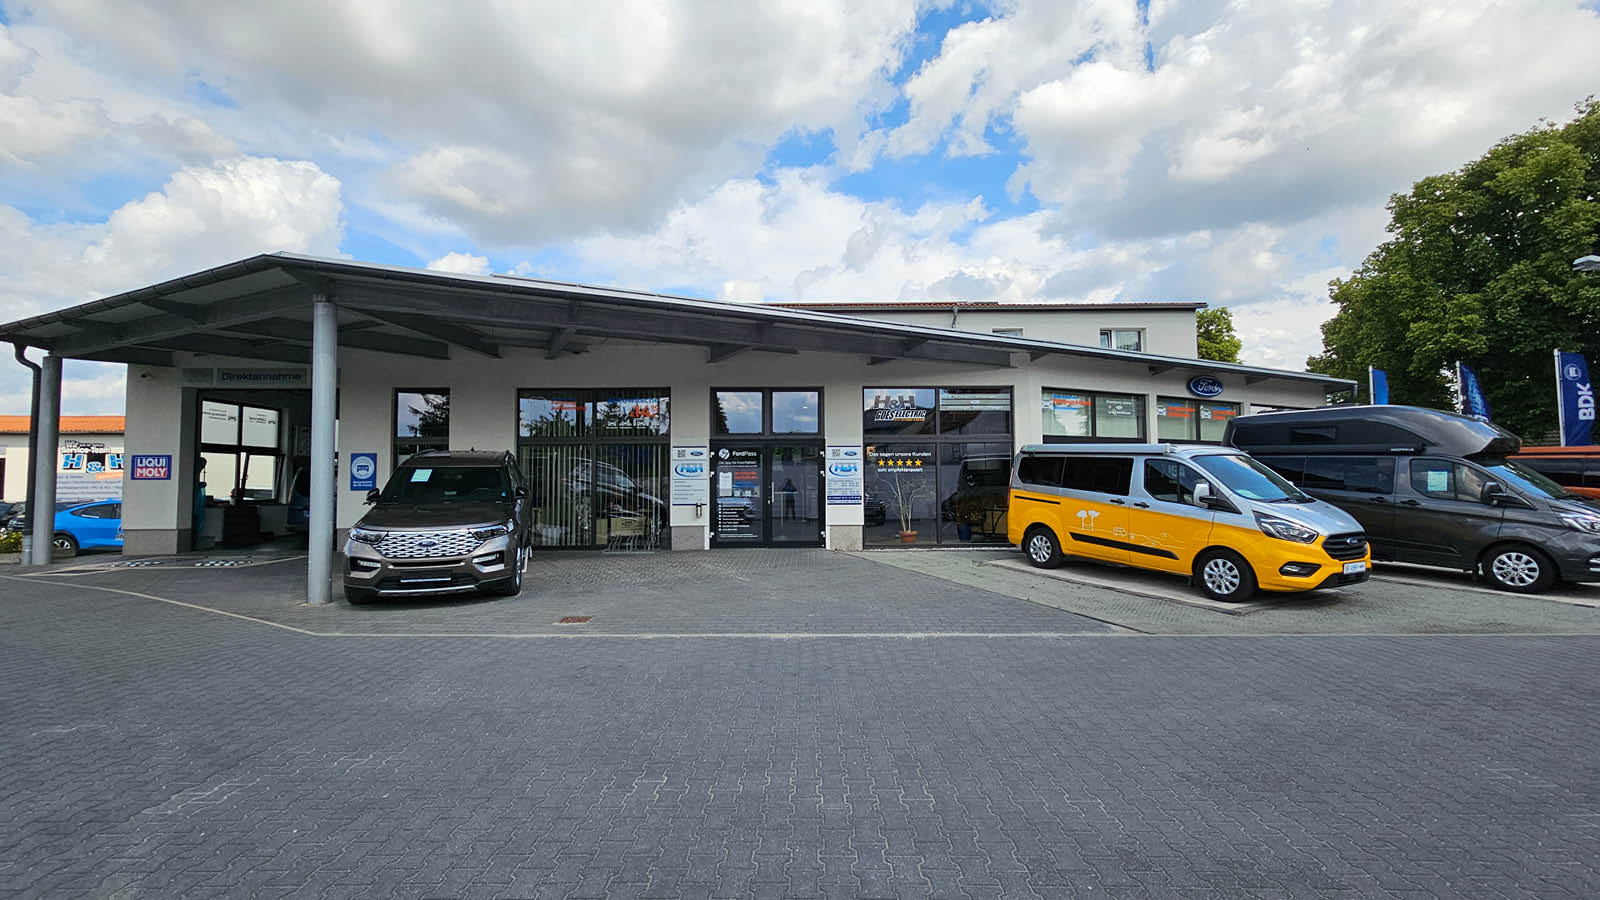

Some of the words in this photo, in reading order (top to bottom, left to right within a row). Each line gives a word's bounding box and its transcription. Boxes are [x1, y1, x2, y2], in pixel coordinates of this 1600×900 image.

[222, 371, 302, 381] Direktannahme
[1197, 379, 1222, 393] Ford
[1576, 382, 1596, 421] BDK
[875, 410, 896, 421] GOES
[895, 409, 927, 419] ELECTRIC
[137, 457, 166, 468] LIQUI
[136, 468, 167, 478] MOLY
